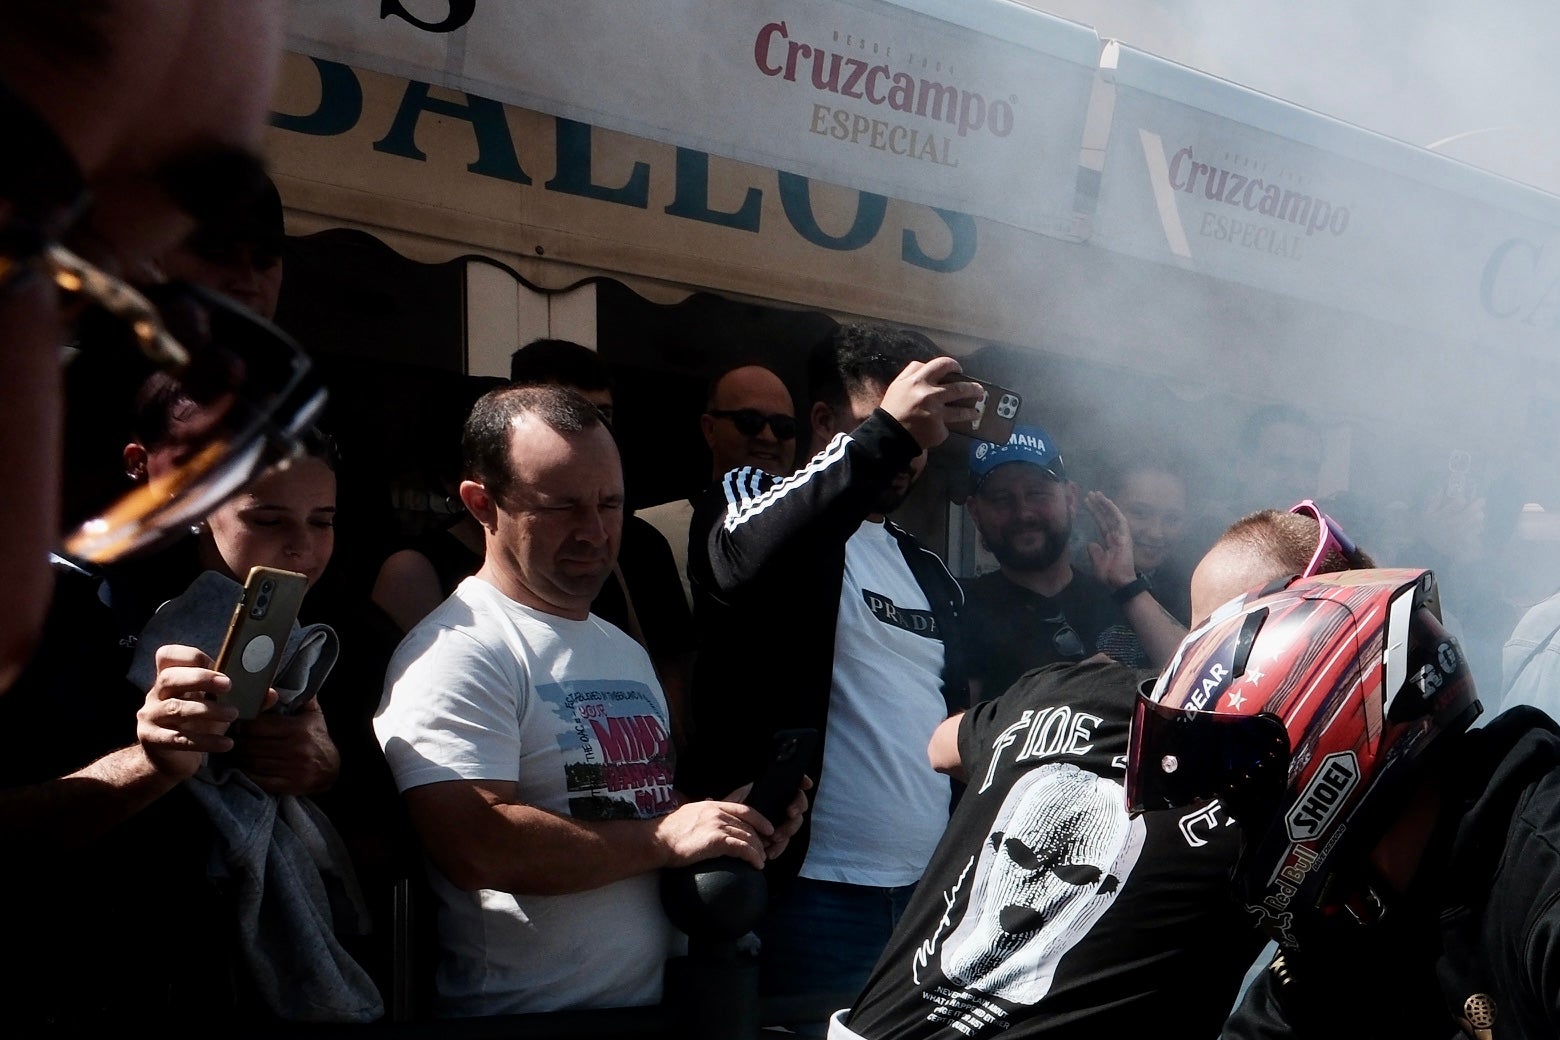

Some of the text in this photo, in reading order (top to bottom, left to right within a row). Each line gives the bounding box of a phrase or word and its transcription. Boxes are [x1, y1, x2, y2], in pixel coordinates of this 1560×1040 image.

[754, 20, 1014, 137] Cruzcampo
[809, 103, 960, 168] ESPECIAL
[1168, 145, 1350, 237] Cruzcampo
[1200, 212, 1303, 261] ESPECIAL
[1293, 762, 1354, 834] SHOEI
[1264, 878, 1297, 911] Red
[1281, 844, 1319, 885] Bull
[988, 1003, 1009, 1018] ABOUT
